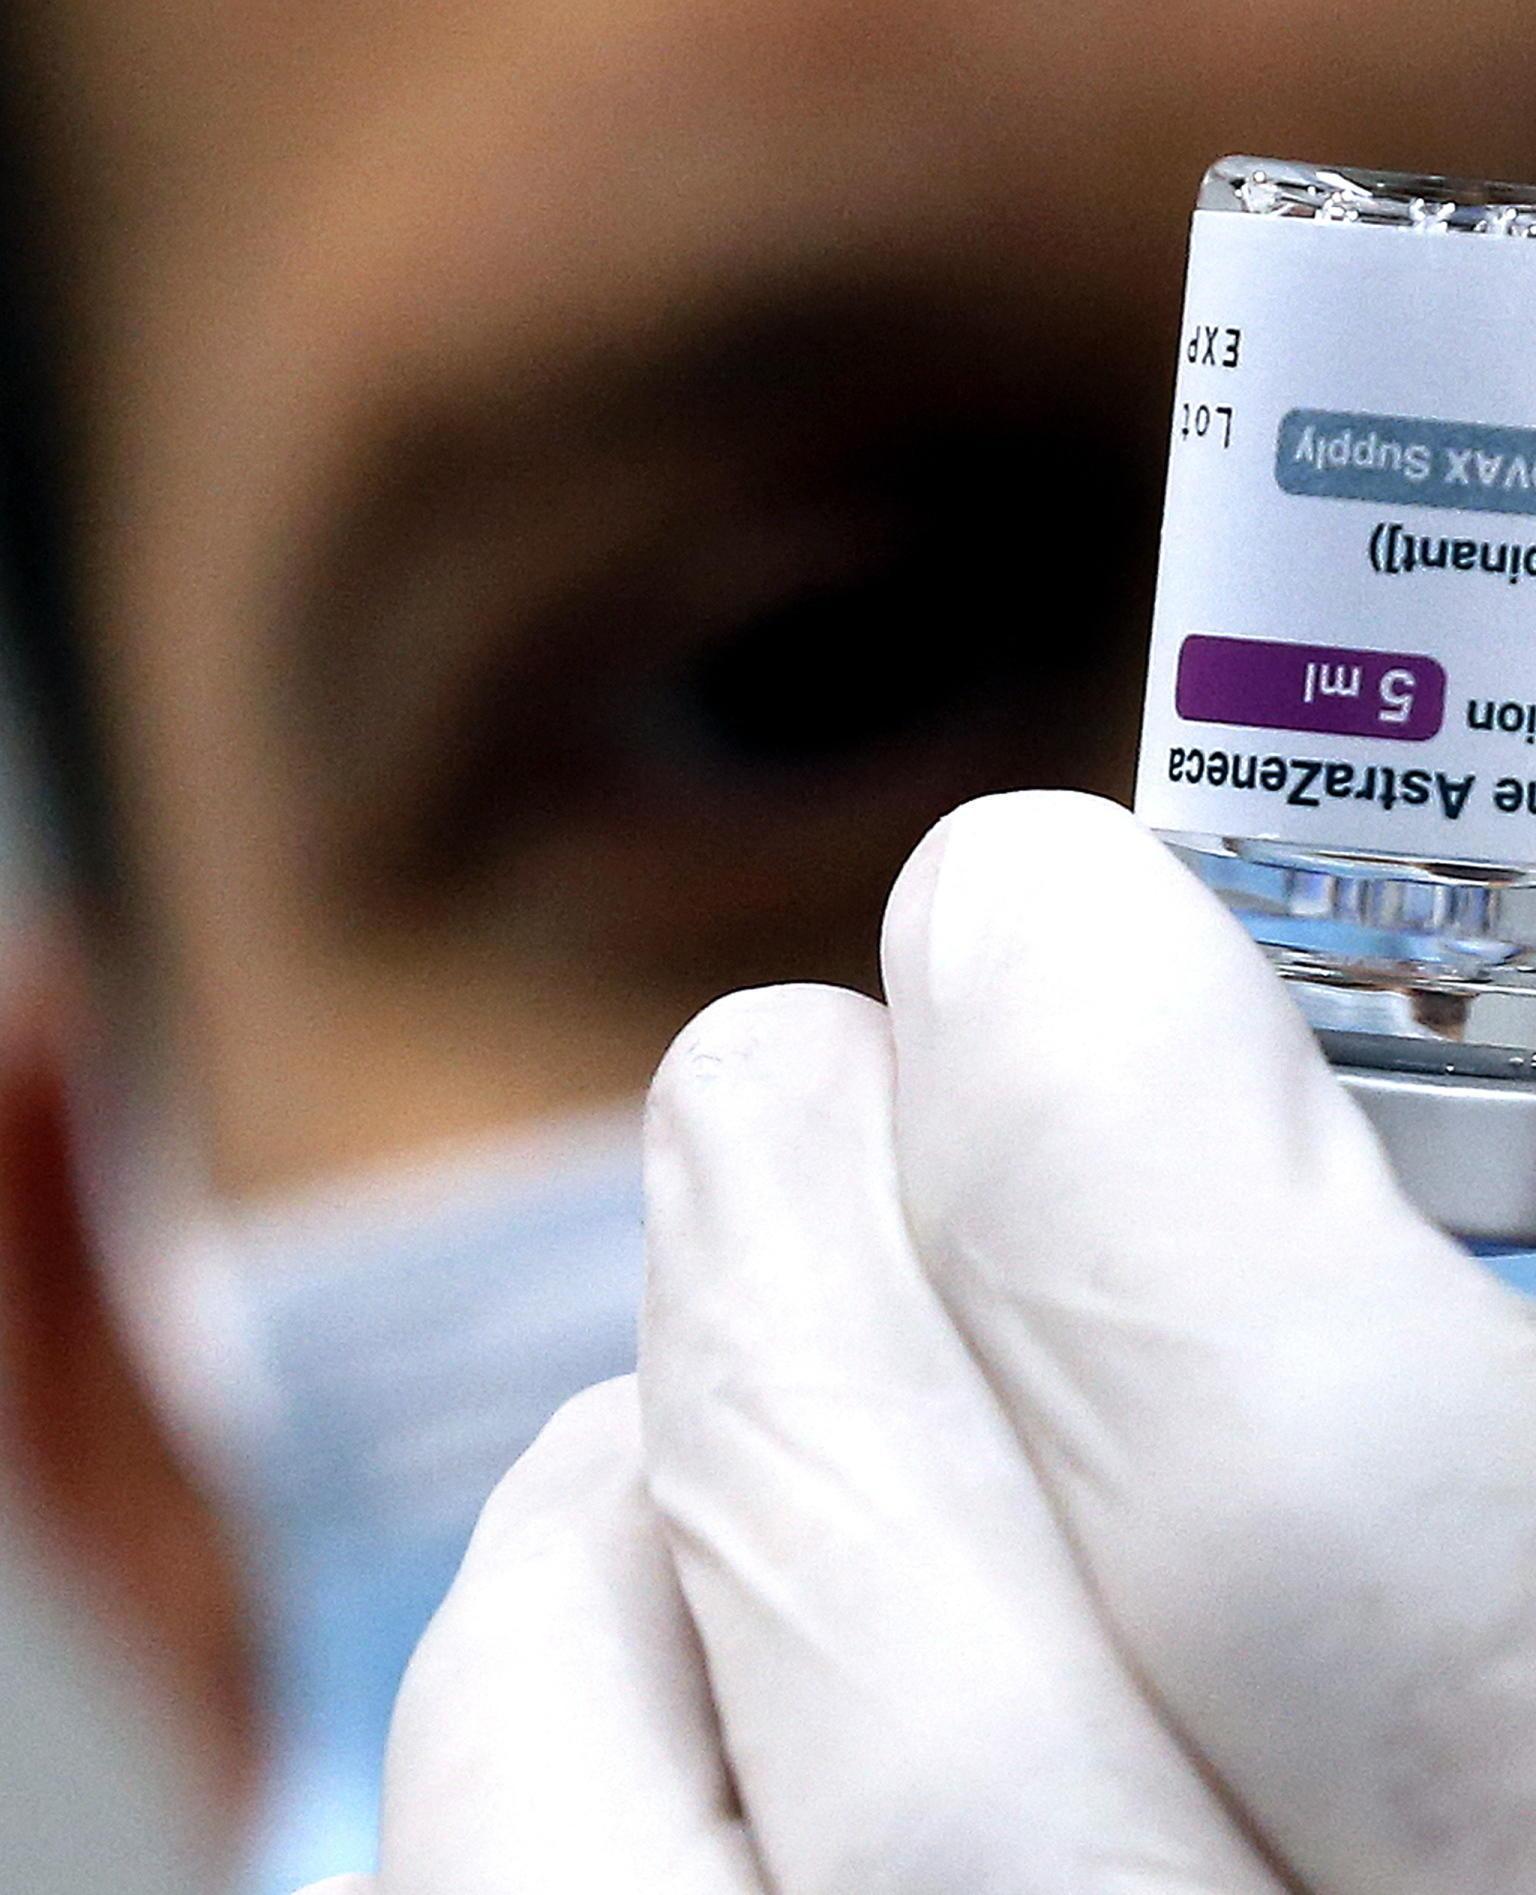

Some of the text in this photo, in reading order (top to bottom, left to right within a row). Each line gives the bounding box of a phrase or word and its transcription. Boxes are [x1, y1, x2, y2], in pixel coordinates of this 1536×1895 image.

[1187, 325, 1242, 369] EXP
[1181, 402, 1233, 449] Lot
[1293, 425, 1431, 482] Supply
[1303, 662, 1416, 723] 5 ml
[1167, 746, 1477, 821] AstraZeneca
